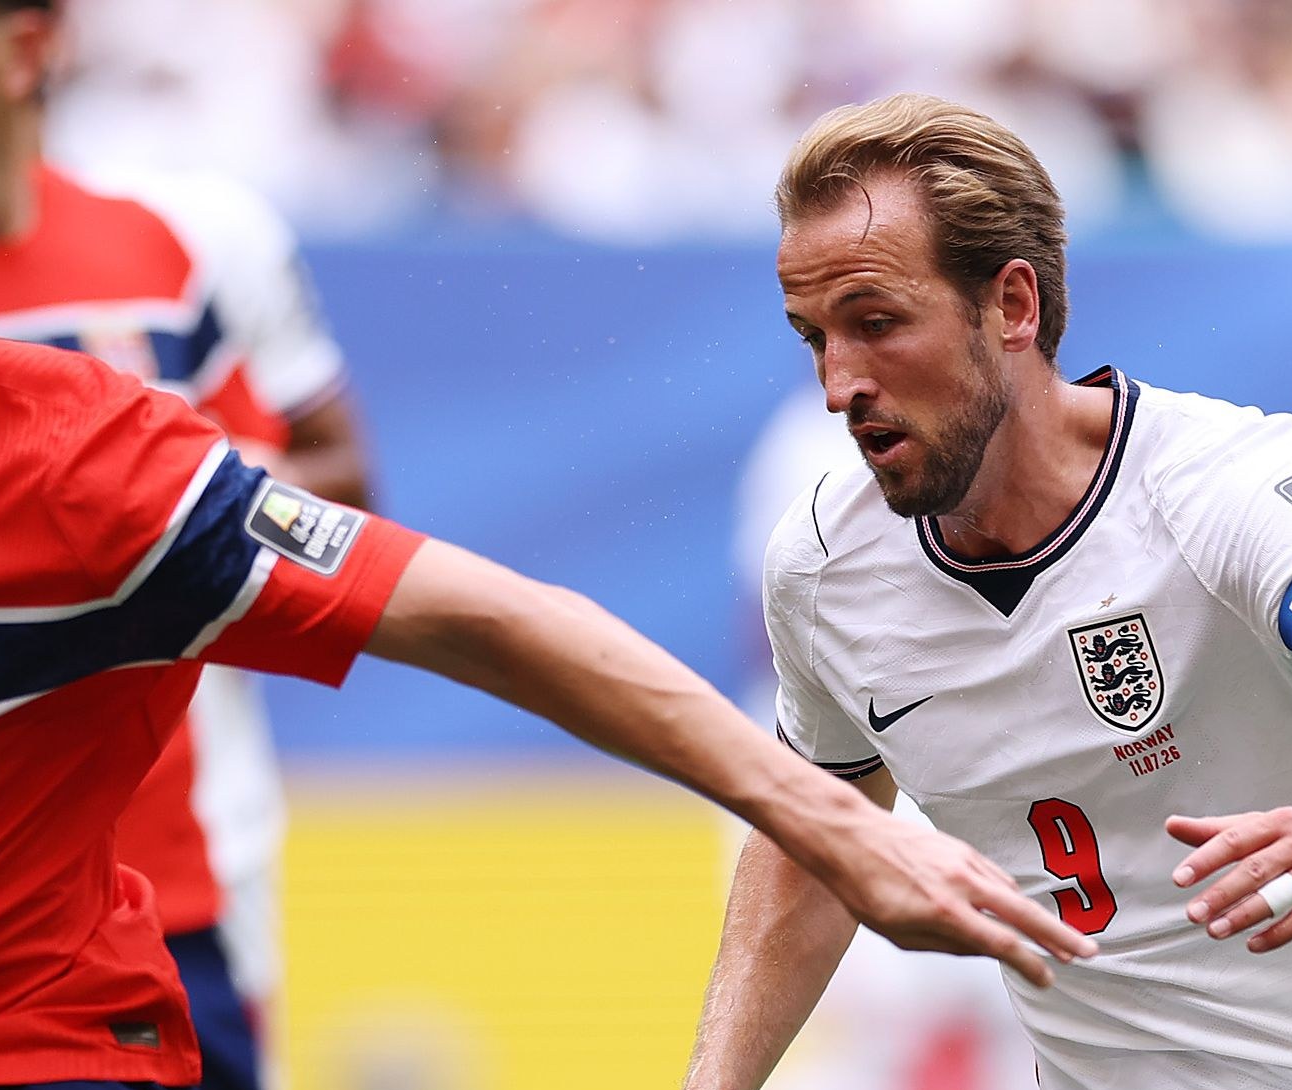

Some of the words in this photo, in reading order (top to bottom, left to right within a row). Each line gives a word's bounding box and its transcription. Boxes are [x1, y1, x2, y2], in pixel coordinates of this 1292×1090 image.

[1113, 723, 1175, 762] NORWAY
[1129, 745, 1181, 777] 11.07.26
[1027, 797, 1118, 936] 9
